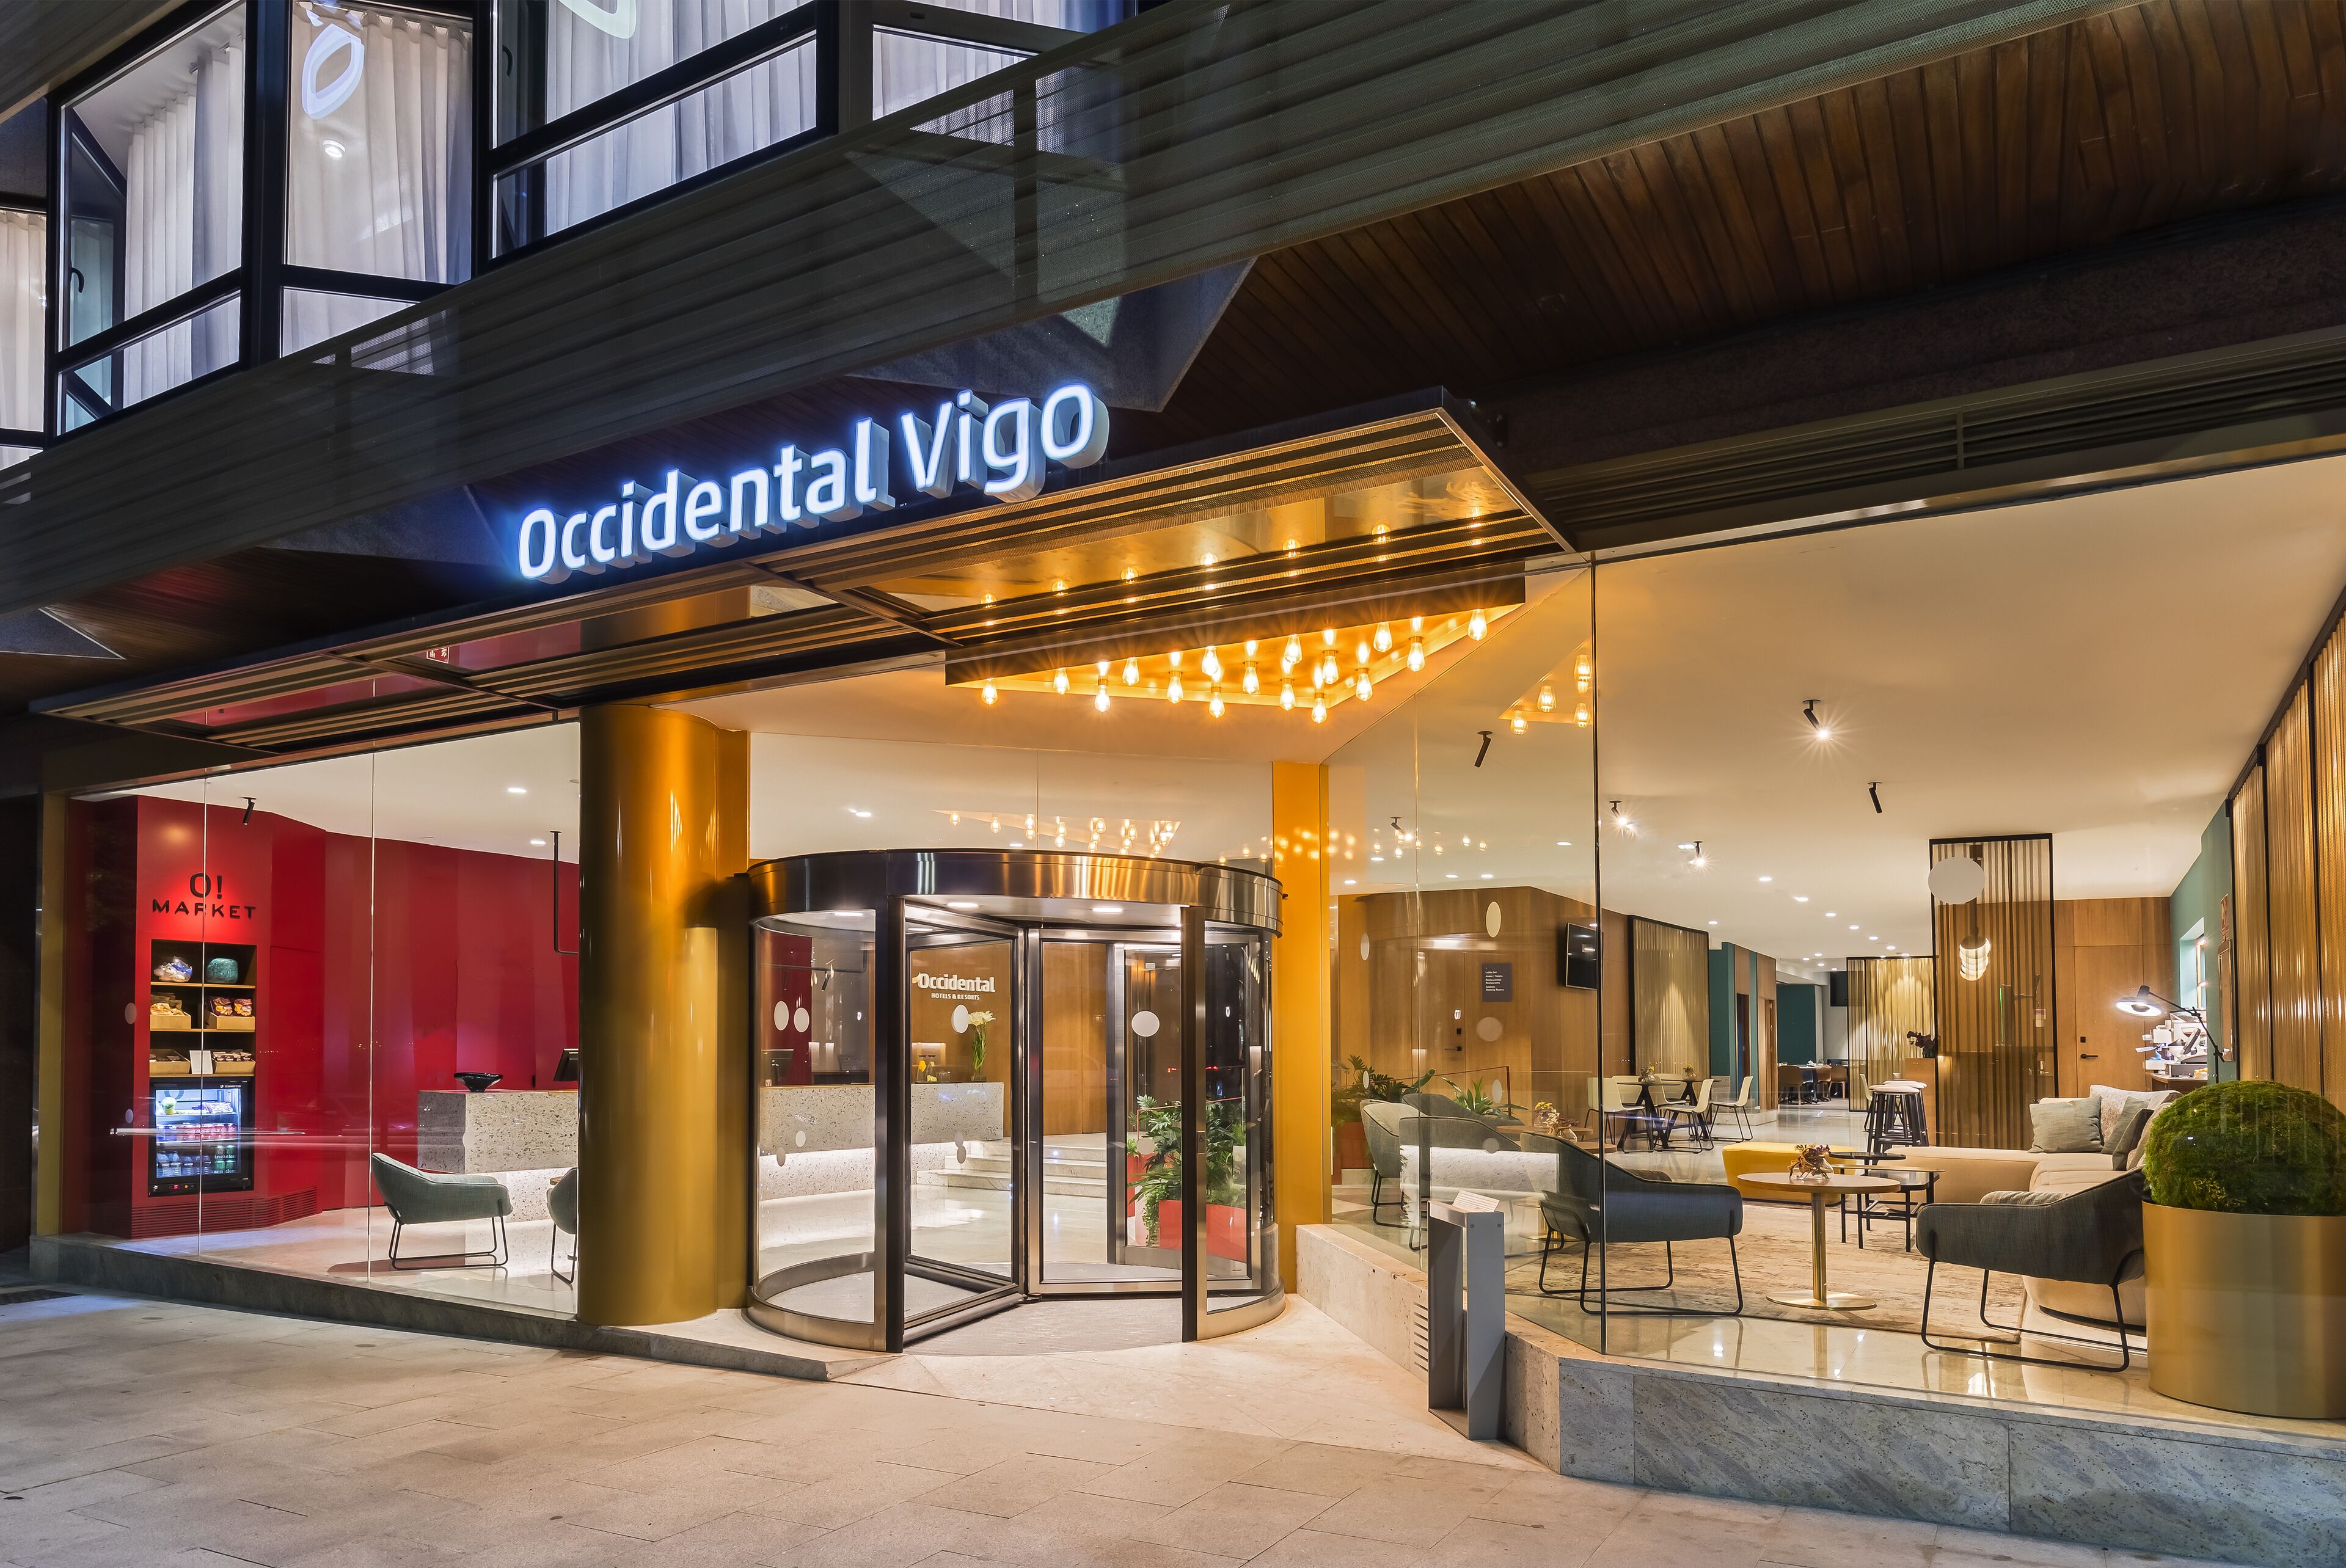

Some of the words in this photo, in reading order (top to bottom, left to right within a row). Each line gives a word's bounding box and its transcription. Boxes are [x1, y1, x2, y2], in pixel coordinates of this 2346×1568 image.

[517, 415, 894, 584] Occidental
[899, 382, 1111, 502] Vigo
[190, 873, 222, 899] O!
[153, 899, 256, 919] MARKET
[918, 973, 996, 992] Occidental
